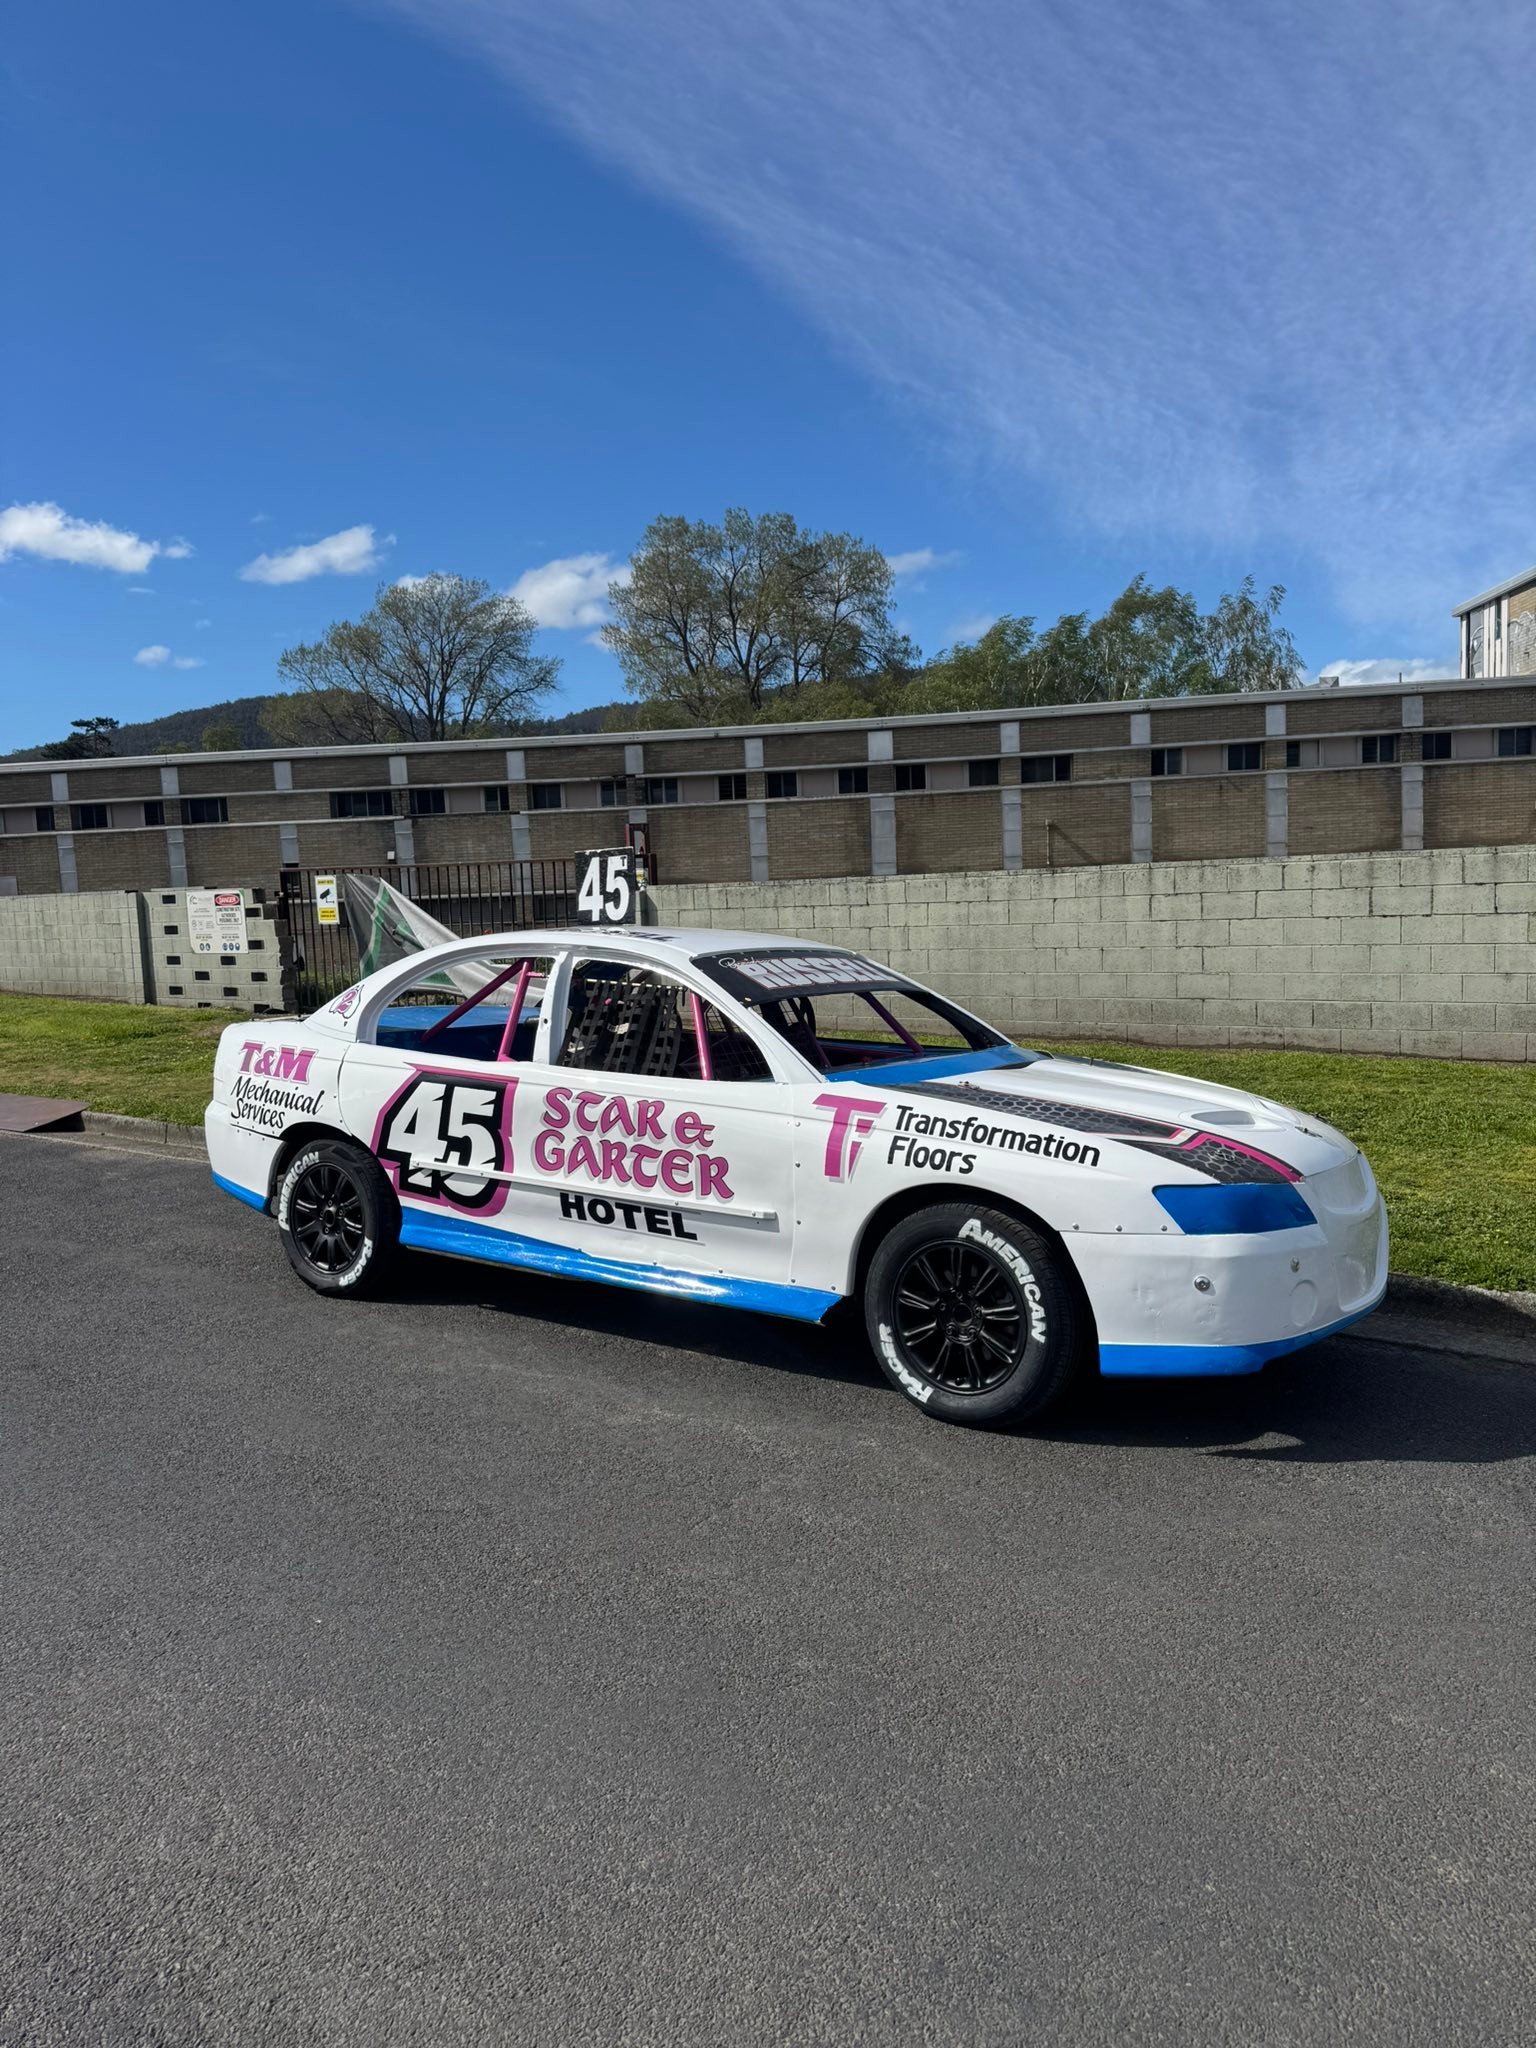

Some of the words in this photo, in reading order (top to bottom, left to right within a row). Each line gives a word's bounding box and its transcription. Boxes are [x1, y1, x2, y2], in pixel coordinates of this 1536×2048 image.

[578, 855, 630, 922] 45
[735, 957, 901, 989] RUSSELL
[238, 1040, 318, 1084] T&M
[230, 1075, 325, 1116] Mechanical
[230, 1097, 286, 1129] Services
[541, 1086, 668, 1141] STAR
[386, 1080, 497, 1197] 45
[887, 1135, 977, 1175] Floors
[896, 1104, 1101, 1168] Transformation
[278, 1151, 320, 1231] AMERICAN
[531, 1128, 735, 1204] GARTER
[559, 1191, 699, 1241] HOTEL
[338, 1236, 373, 1287] RACER
[957, 1217, 1048, 1344] AMERICAN
[878, 1322, 935, 1404] RACER
